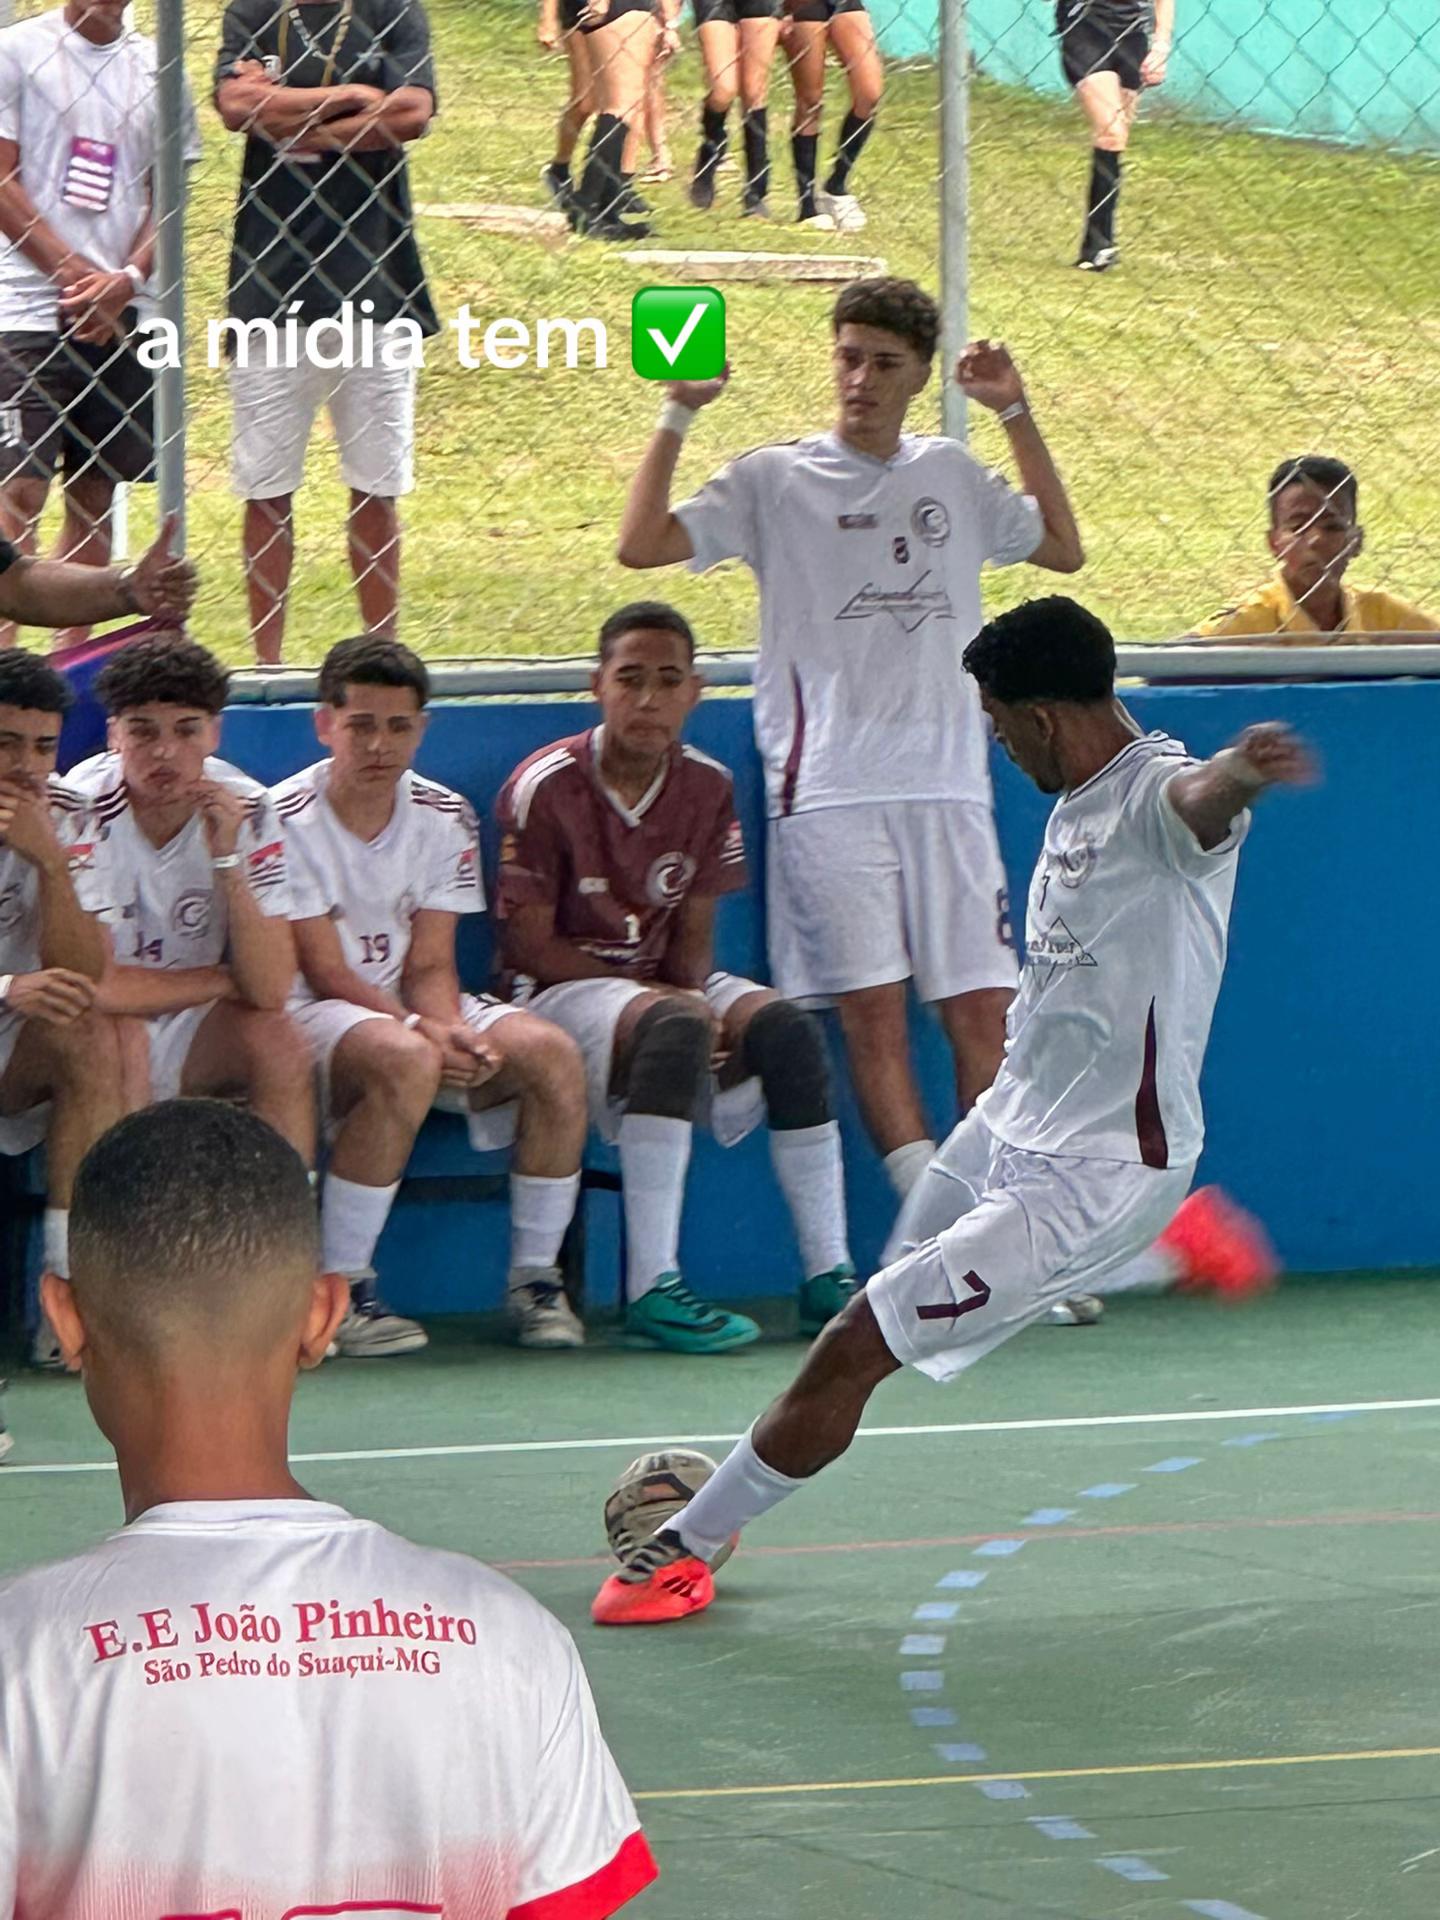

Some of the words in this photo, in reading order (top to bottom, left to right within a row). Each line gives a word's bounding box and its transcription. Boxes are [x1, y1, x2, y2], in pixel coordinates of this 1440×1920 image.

[624, 913, 641, 944] 1
[359, 932, 391, 964] 19
[915, 1270, 991, 1320] 7
[83, 1608, 180, 1663] E.E
[190, 1602, 281, 1644] João
[292, 1598, 477, 1646] Pinheiro
[144, 1659, 191, 1685] São
[195, 1650, 261, 1677] Pedro
[266, 1652, 291, 1677] do
